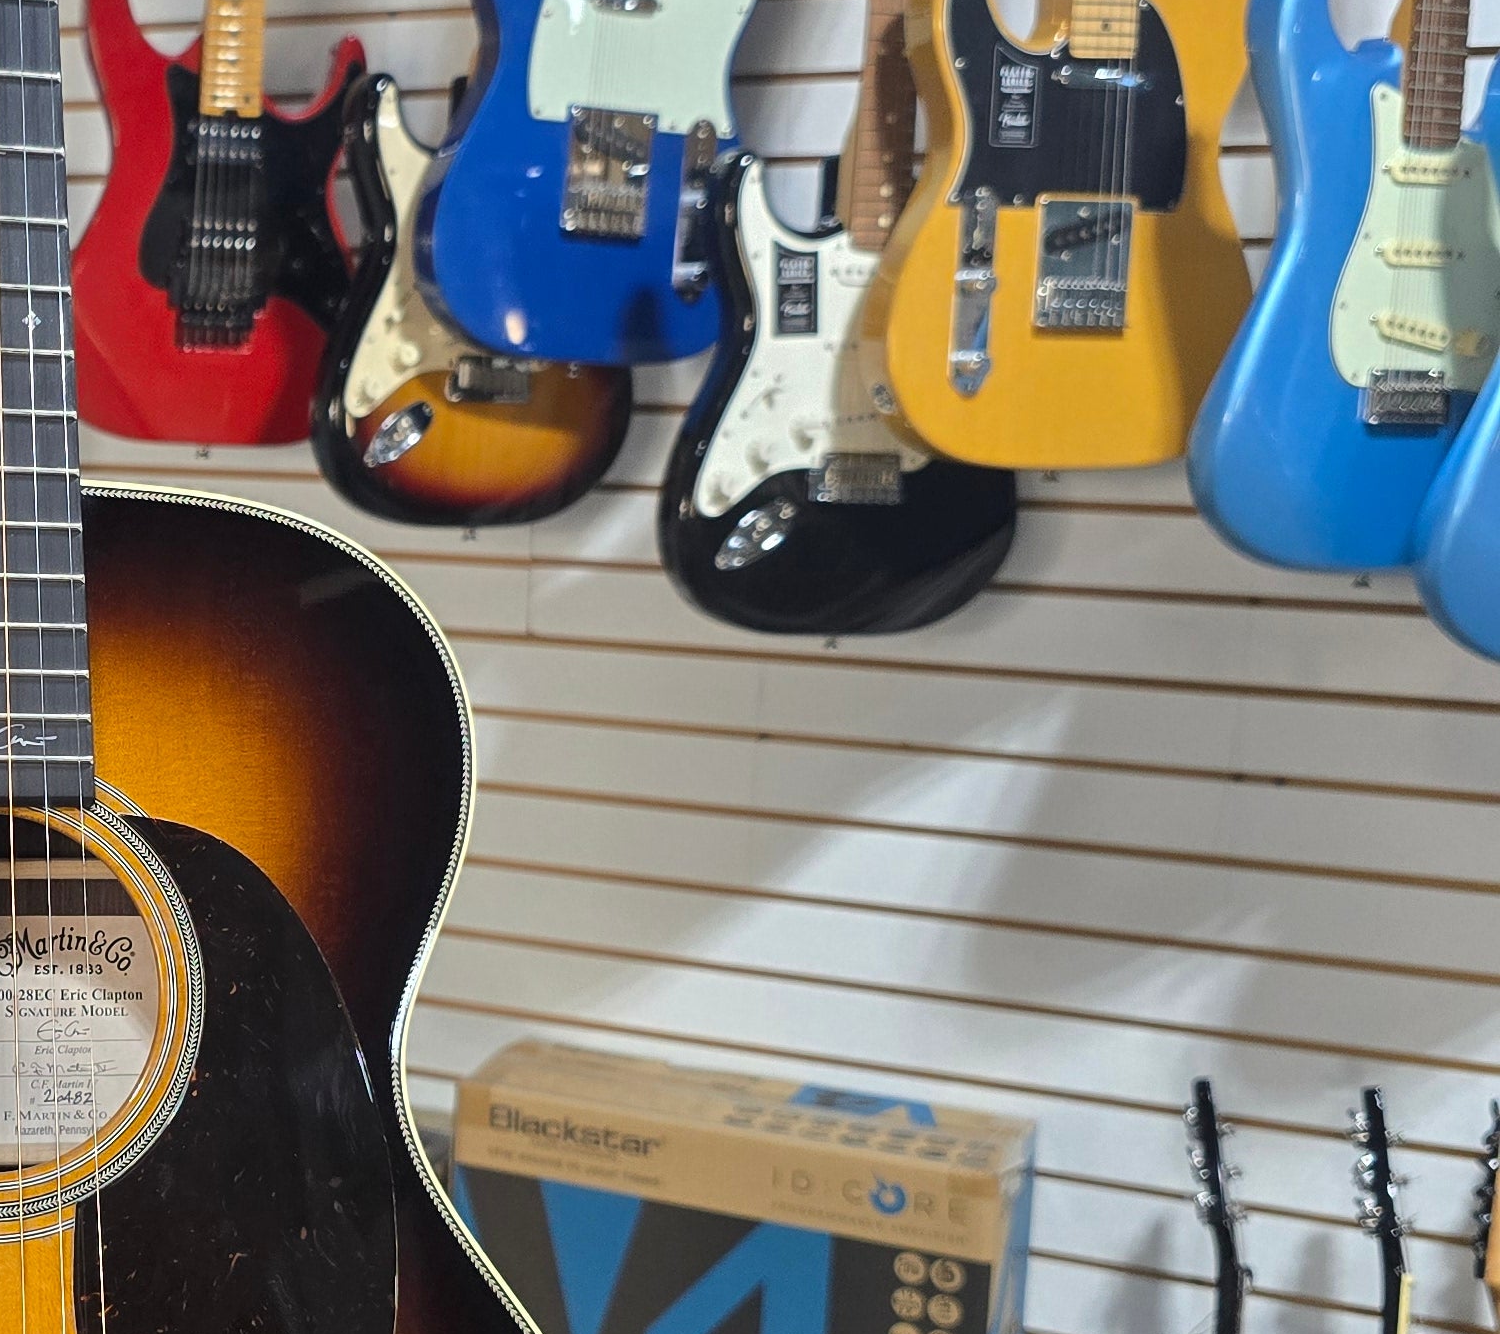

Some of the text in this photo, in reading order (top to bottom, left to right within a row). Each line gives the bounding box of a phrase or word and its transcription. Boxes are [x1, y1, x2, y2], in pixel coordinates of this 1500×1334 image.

[34, 964, 103, 975] EST. 1833
[61, 988, 87, 1001] Eric
[92, 988, 143, 1003] Clapton
[5, 1005, 129, 1017] SGNATURE MODEL
[35, 1045, 54, 1055] Eric
[73, 1109, 85, 1120] &
[488, 1103, 662, 1156] Blackstar
